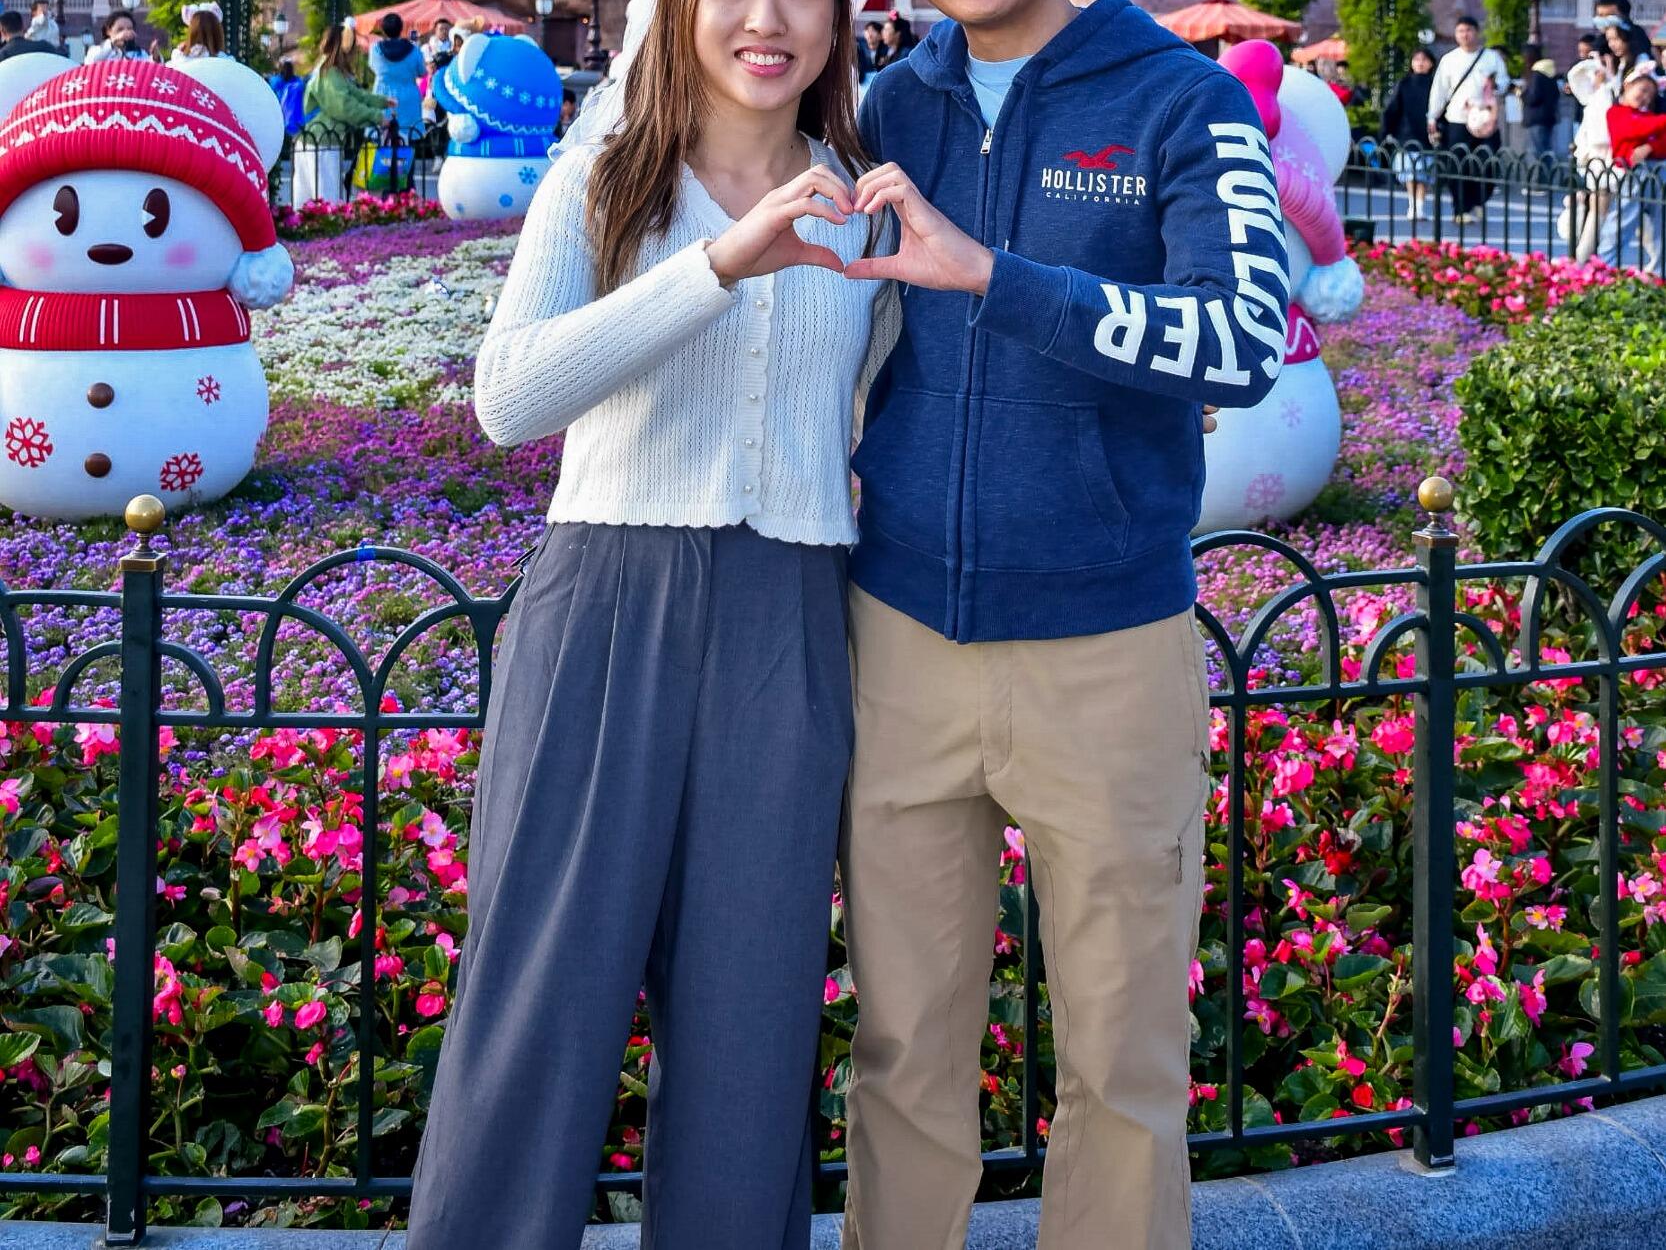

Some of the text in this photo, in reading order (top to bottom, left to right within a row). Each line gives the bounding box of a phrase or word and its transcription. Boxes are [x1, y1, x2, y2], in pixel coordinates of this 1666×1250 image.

[1041, 168, 1146, 196] HOLLISTER
[1046, 191, 1140, 205] CALIFORNIA
[1094, 122, 1291, 386] HOLLISTER
